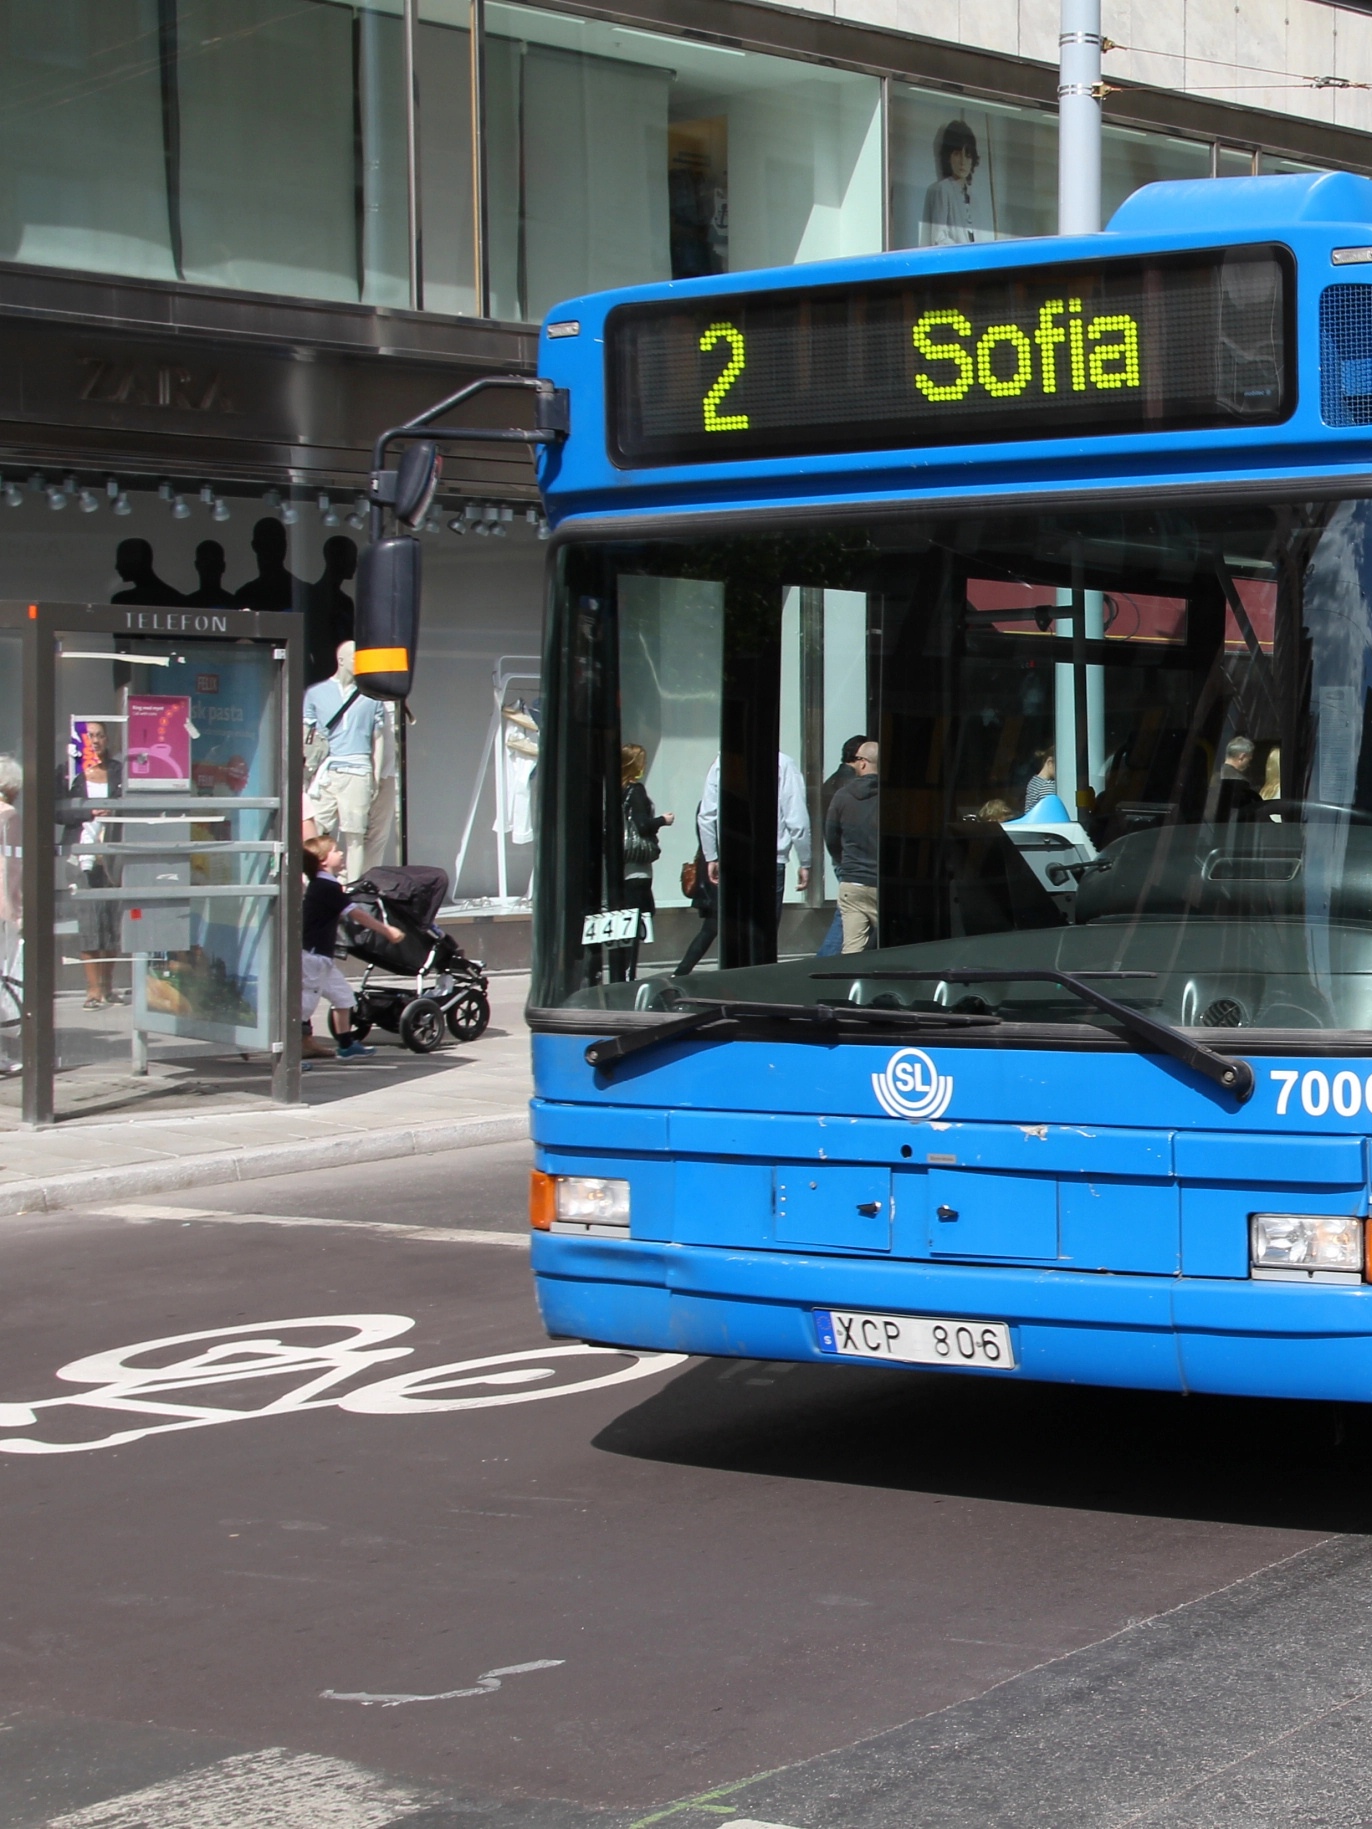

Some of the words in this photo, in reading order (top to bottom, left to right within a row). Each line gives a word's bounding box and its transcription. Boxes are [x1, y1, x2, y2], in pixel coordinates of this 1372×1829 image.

[700, 322, 749, 431] 2
[912, 297, 1140, 402] Sofia
[126, 612, 227, 632] TELEFON
[208, 706, 243, 725] pasta
[585, 917, 633, 940] 447
[894, 1062, 931, 1092] SL
[823, 1335, 833, 1345] S
[837, 1316, 899, 1354] XCP
[933, 1325, 1000, 1361] 806
